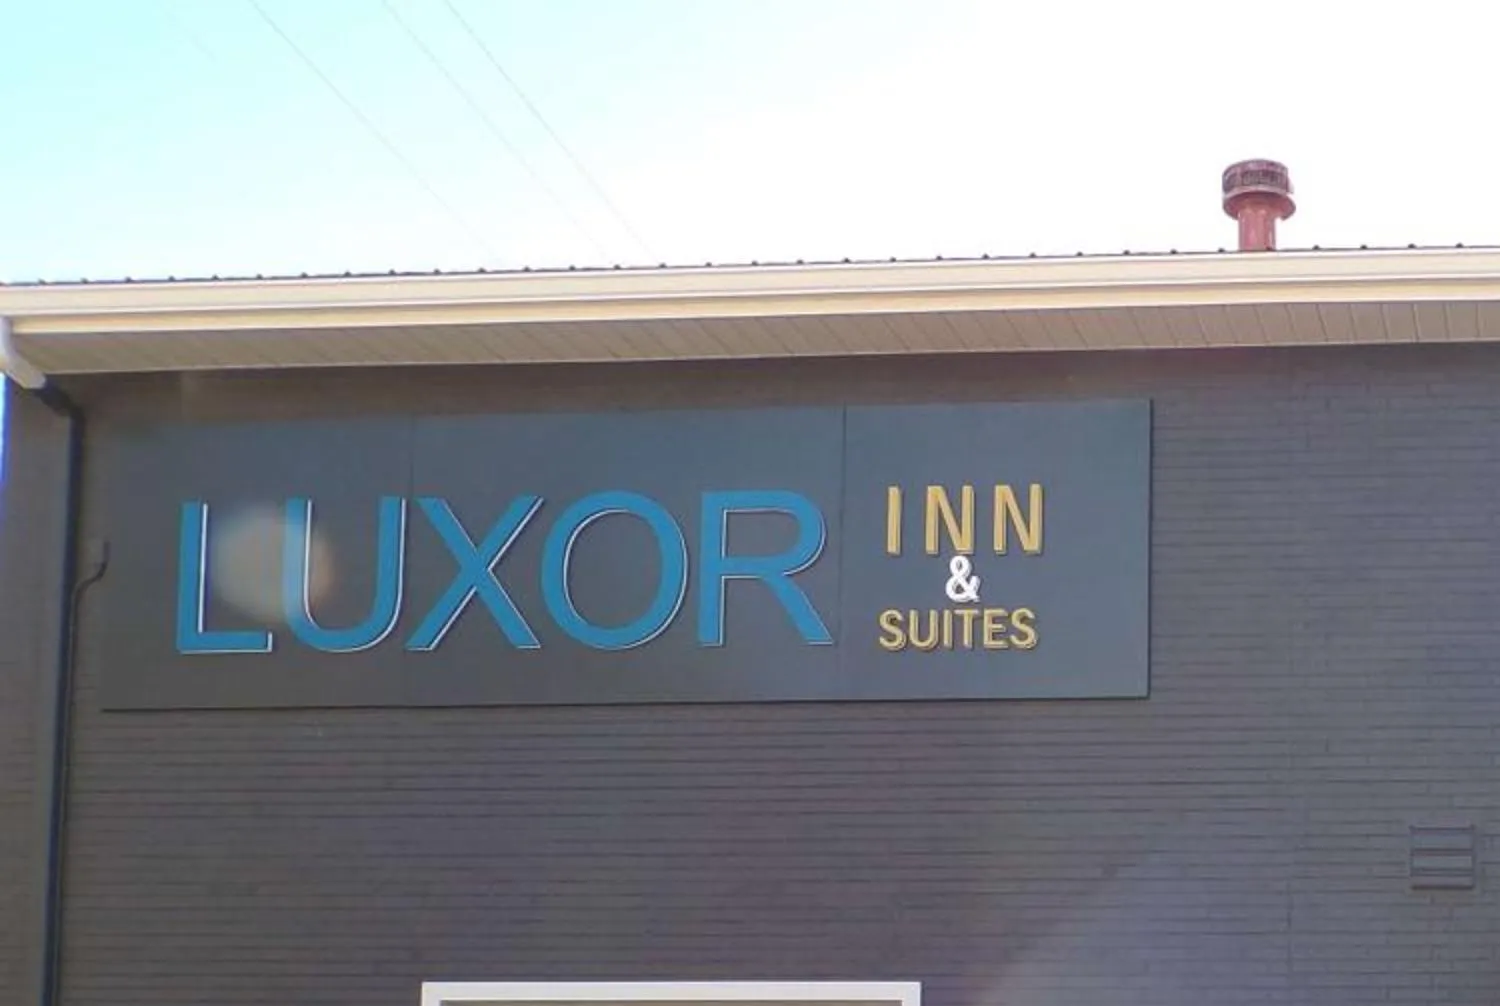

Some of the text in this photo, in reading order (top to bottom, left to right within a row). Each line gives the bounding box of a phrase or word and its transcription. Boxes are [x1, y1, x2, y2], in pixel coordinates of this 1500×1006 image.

[887, 483, 1043, 555] INN
[175, 490, 835, 656] LUXOR
[945, 556, 981, 602] &
[879, 608, 1037, 649] SUITES
